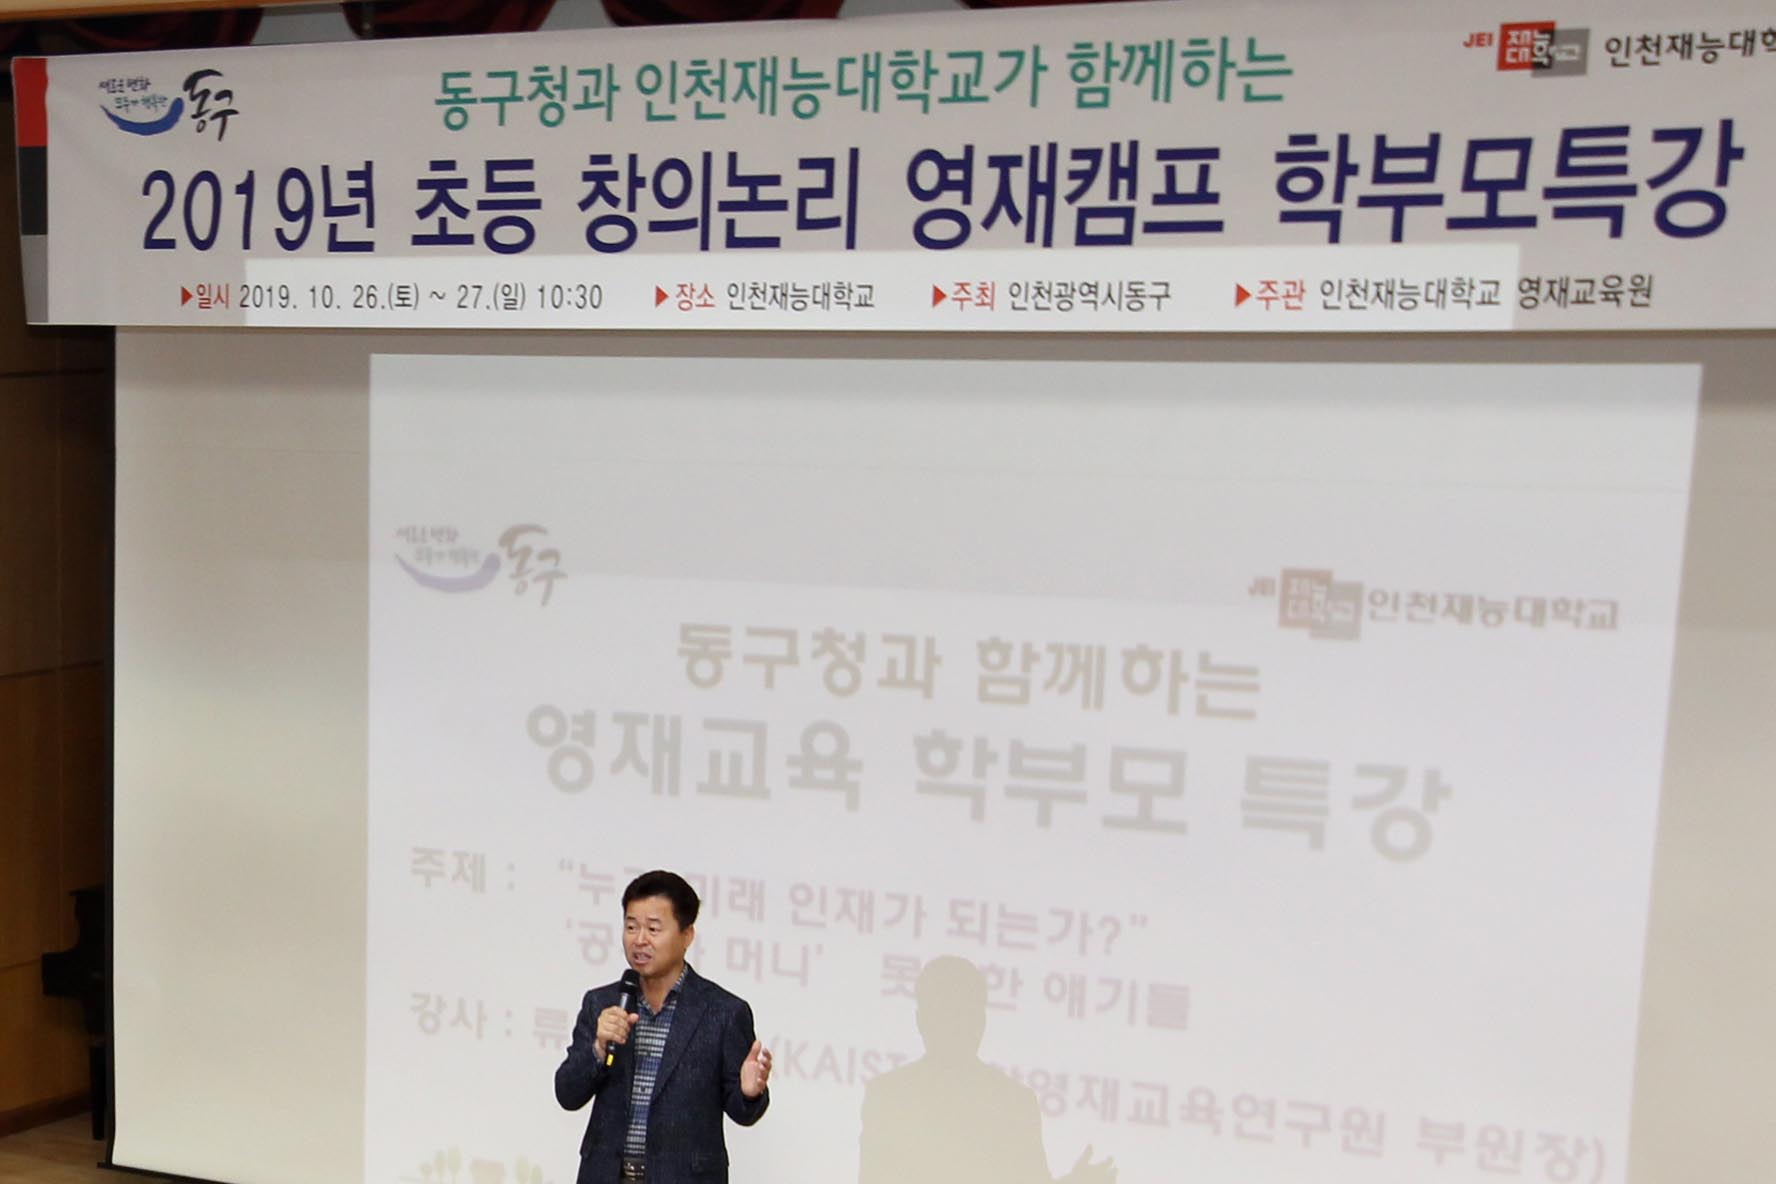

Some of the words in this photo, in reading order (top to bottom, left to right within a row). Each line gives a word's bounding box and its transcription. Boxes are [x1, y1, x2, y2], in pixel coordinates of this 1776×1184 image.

[1463, 32, 1493, 48] JEI
[182, 69, 239, 141] 동구
[435, 63, 620, 131] 동구청과
[636, 45, 1048, 122] 인천재능대학교가
[1067, 36, 1293, 109] 함께하는
[142, 161, 375, 253] 2019년
[411, 159, 542, 254] 초등
[577, 147, 860, 254] 창의논리
[906, 140, 1225, 251] 영재캠프
[1274, 119, 1746, 244] 학부모특강
[197, 284, 229, 309] 일시
[238, 284, 297, 309] 2019.
[309, 284, 341, 309] 10.
[353, 282, 420, 311] 26.(토)
[457, 282, 526, 312] 27.(일)
[538, 284, 603, 309] 10:30
[676, 282, 716, 311] 장소
[727, 281, 875, 312] 인천재능대학교
[952, 282, 996, 311] 주최
[1008, 280, 1171, 312] 인천광역시동구
[1257, 280, 1307, 310] 주관
[1320, 277, 1501, 311] 인천재능대학교
[1519, 274, 1653, 310] 영재교육원
[499, 523, 568, 606] 동구
[1368, 589, 1619, 630] 인천재능대학교
[678, 622, 942, 700] 동구청과
[976, 635, 1261, 721] 함께하는
[525, 703, 864, 812] 영재교육
[913, 727, 1188, 836] 학부모
[1240, 753, 1453, 863] 특강
[410, 846, 487, 894] 주제
[788, 881, 928, 940] 인재가
[410, 991, 488, 1040] 강사
